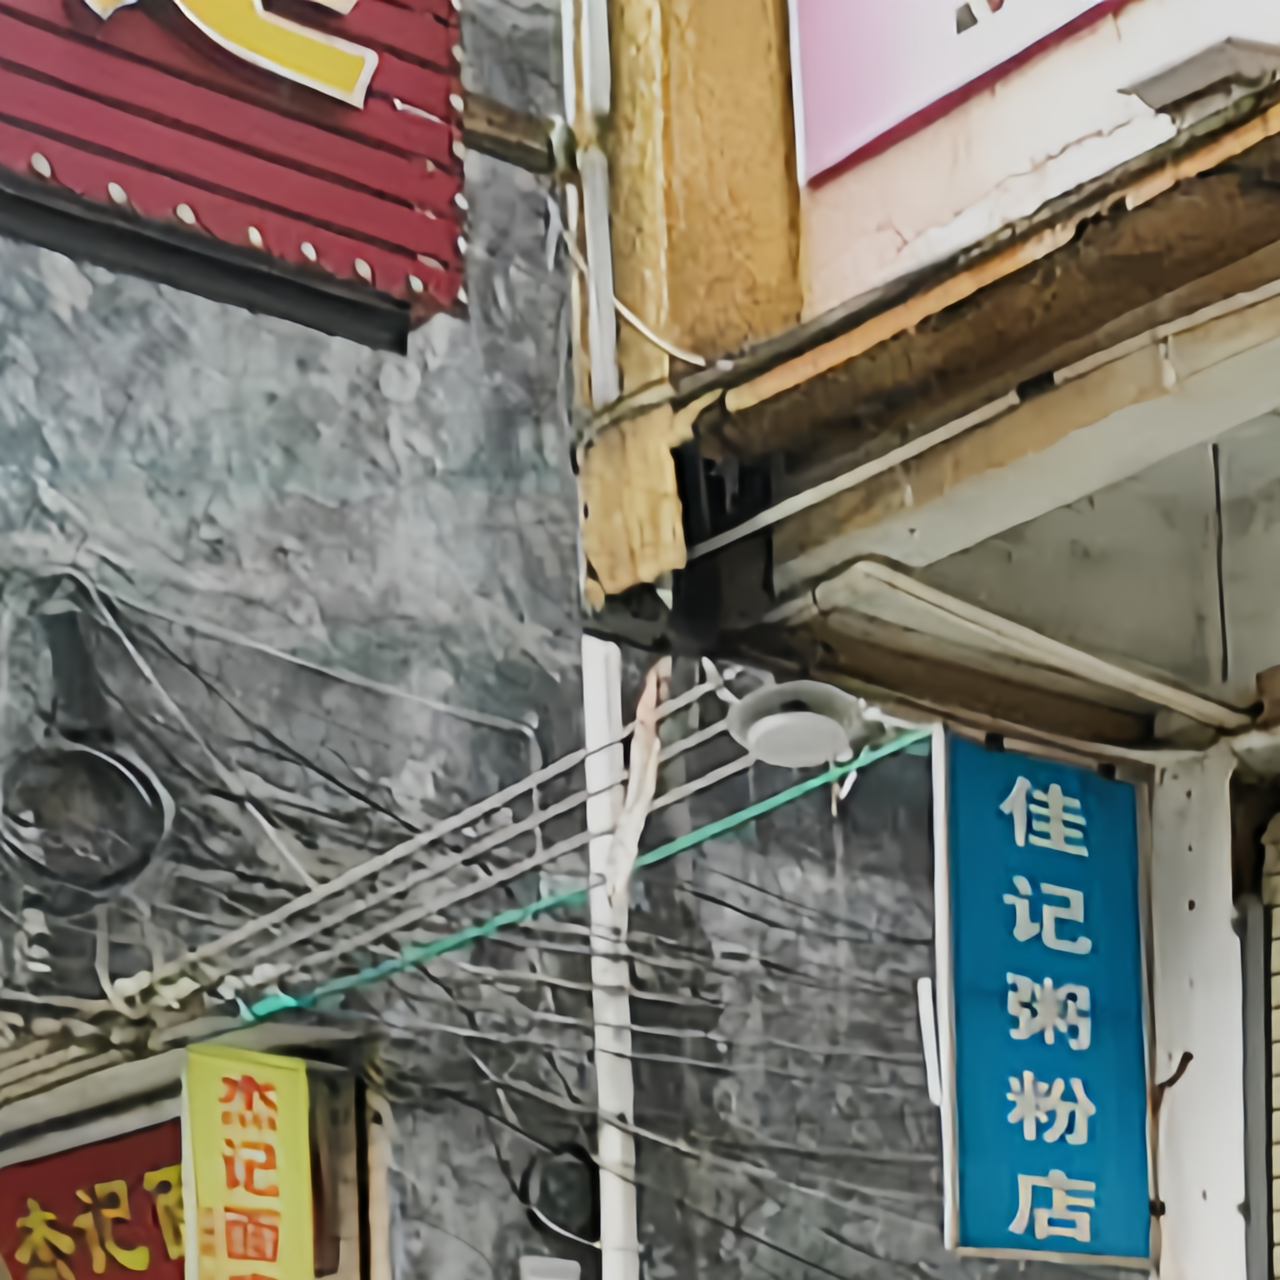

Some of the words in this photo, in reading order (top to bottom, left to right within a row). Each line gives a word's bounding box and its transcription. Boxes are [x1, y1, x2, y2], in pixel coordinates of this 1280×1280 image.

[998, 775, 1096, 1243] 佳记粥粉店
